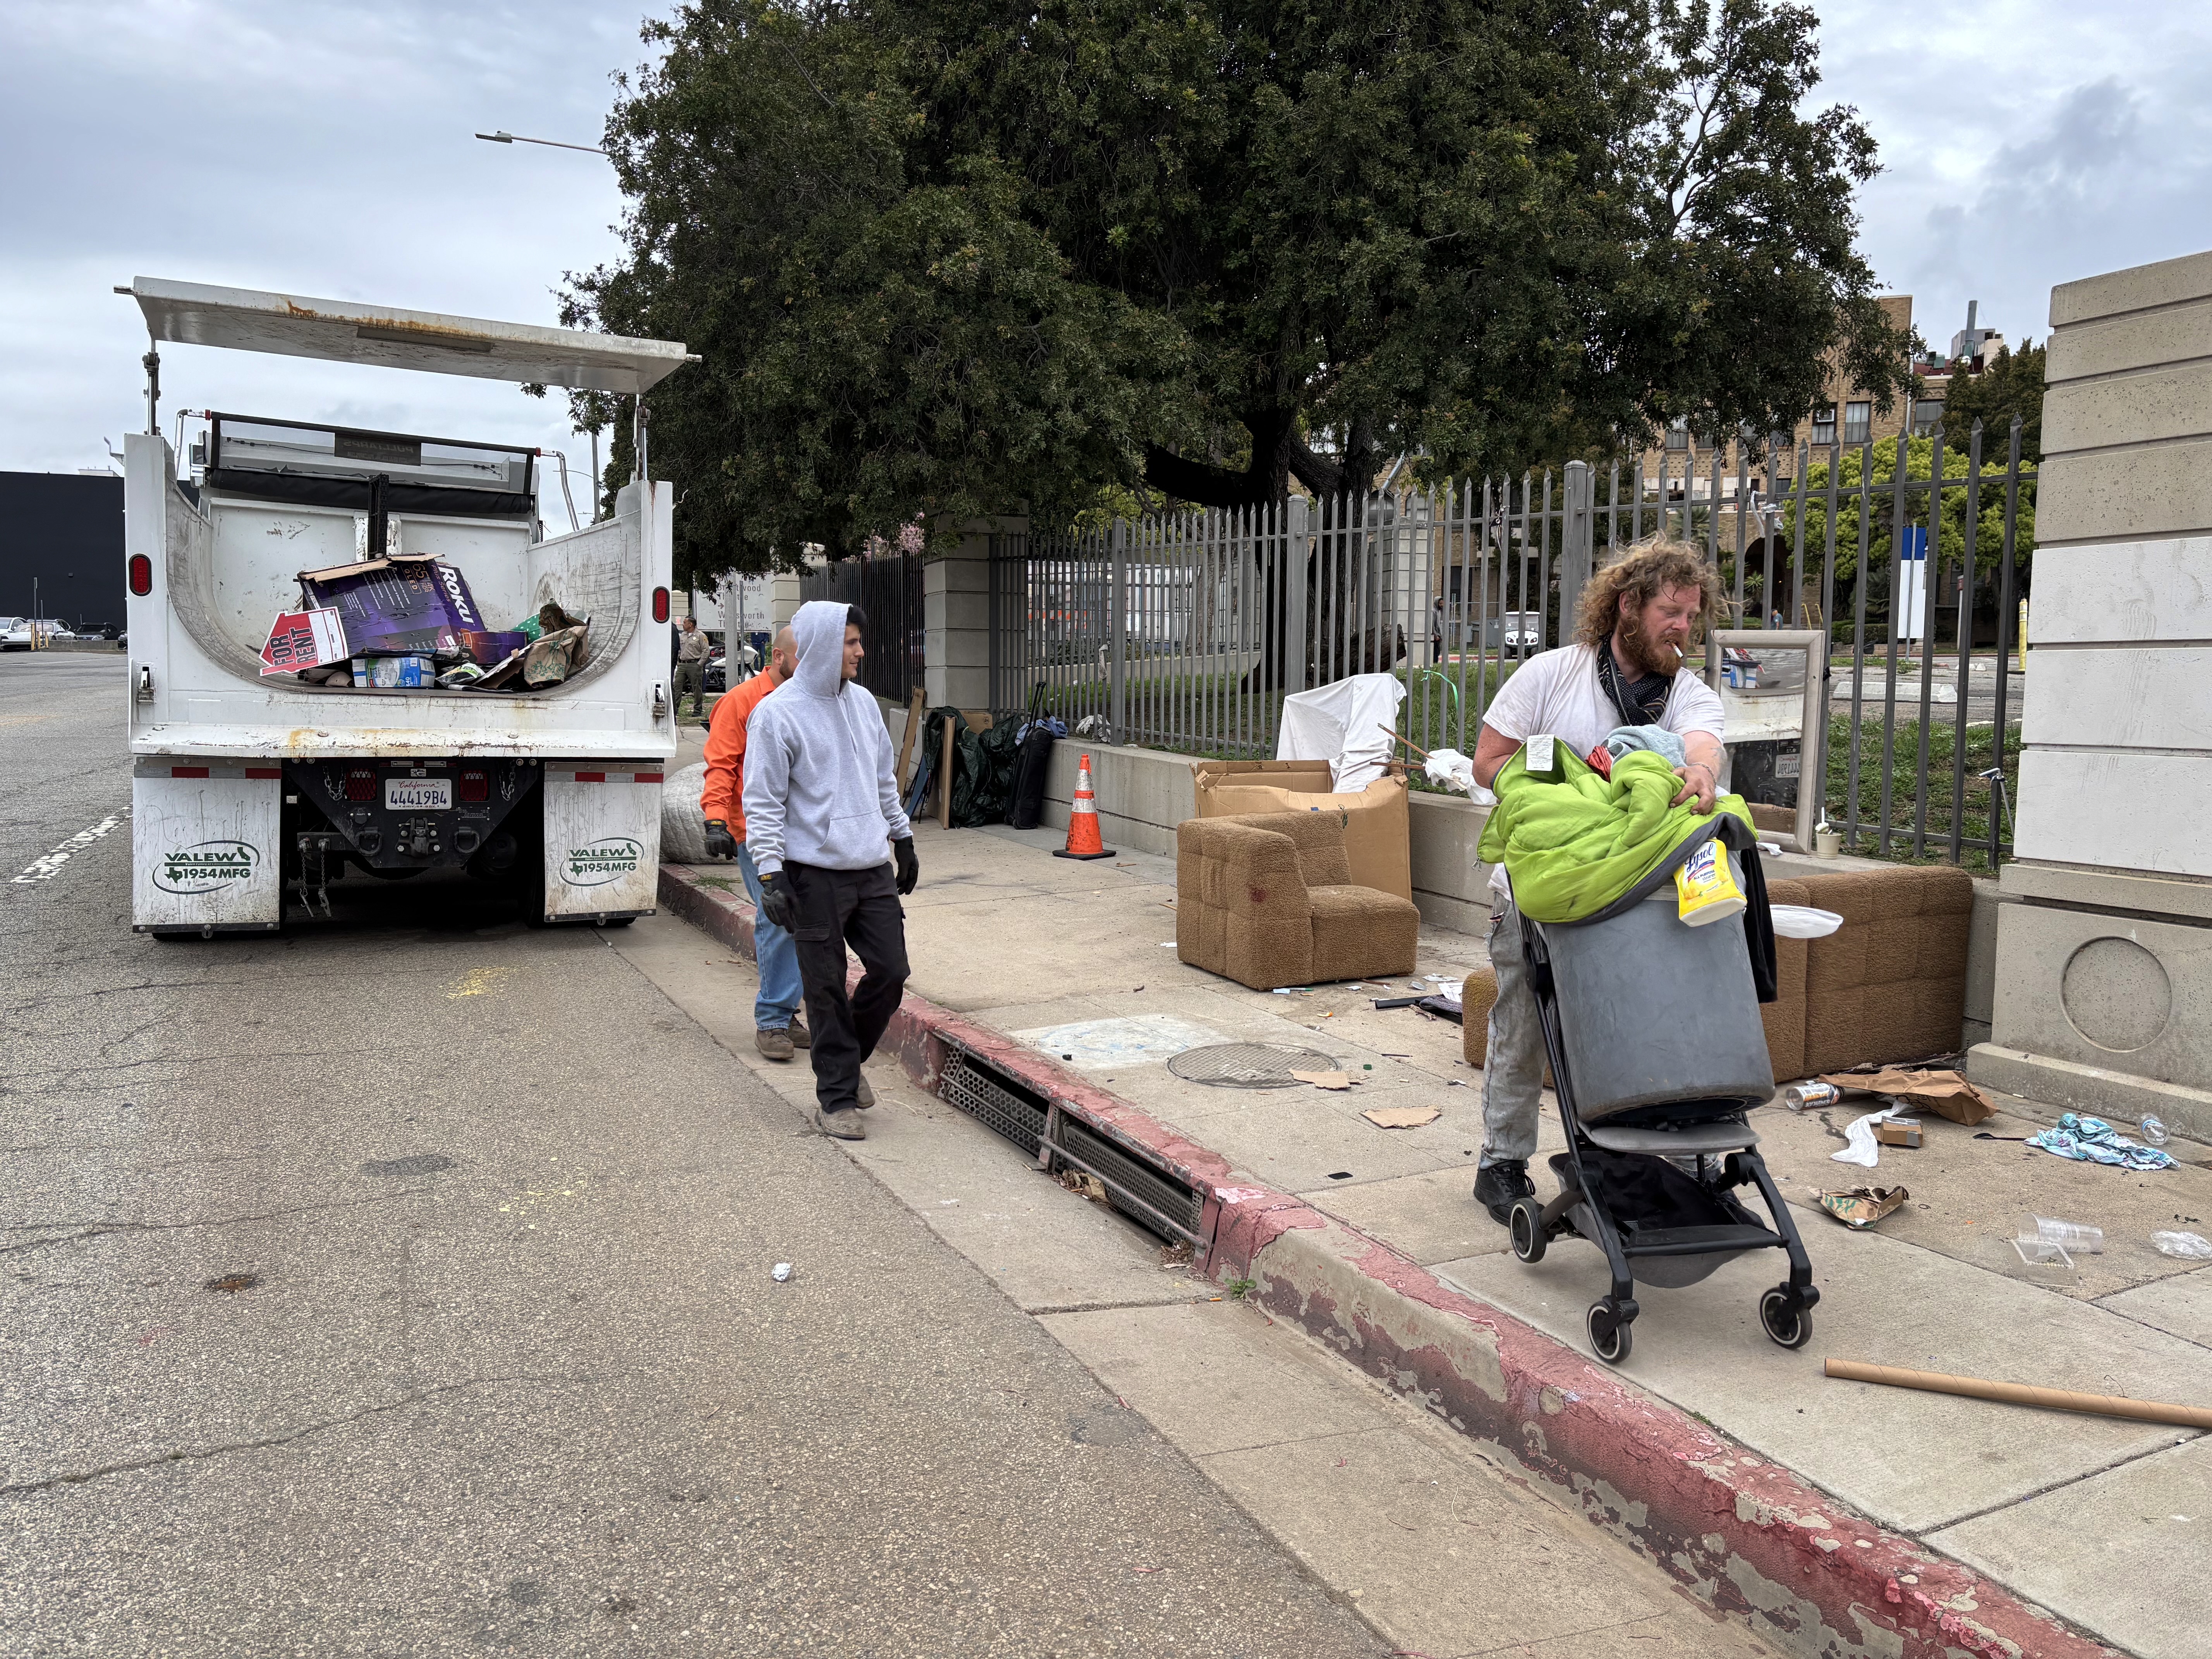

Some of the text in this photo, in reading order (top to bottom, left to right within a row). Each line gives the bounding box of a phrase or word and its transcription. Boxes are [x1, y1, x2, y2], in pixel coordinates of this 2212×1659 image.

[412, 563, 429, 579] 65
[404, 568, 418, 590] QLED
[431, 565, 451, 602] Plus Series
[421, 582, 429, 593] HDR
[427, 582, 436, 592] 4K
[717, 584, 761, 592] Brtood
[270, 634, 294, 666] FOR
[289, 627, 317, 664] RENT
[399, 781, 440, 790] California
[390, 790, 447, 805] 44419B4
[164, 853, 237, 861] VALEW
[569, 848, 626, 857] VALEW
[1685, 843, 1714, 872] Lysol
